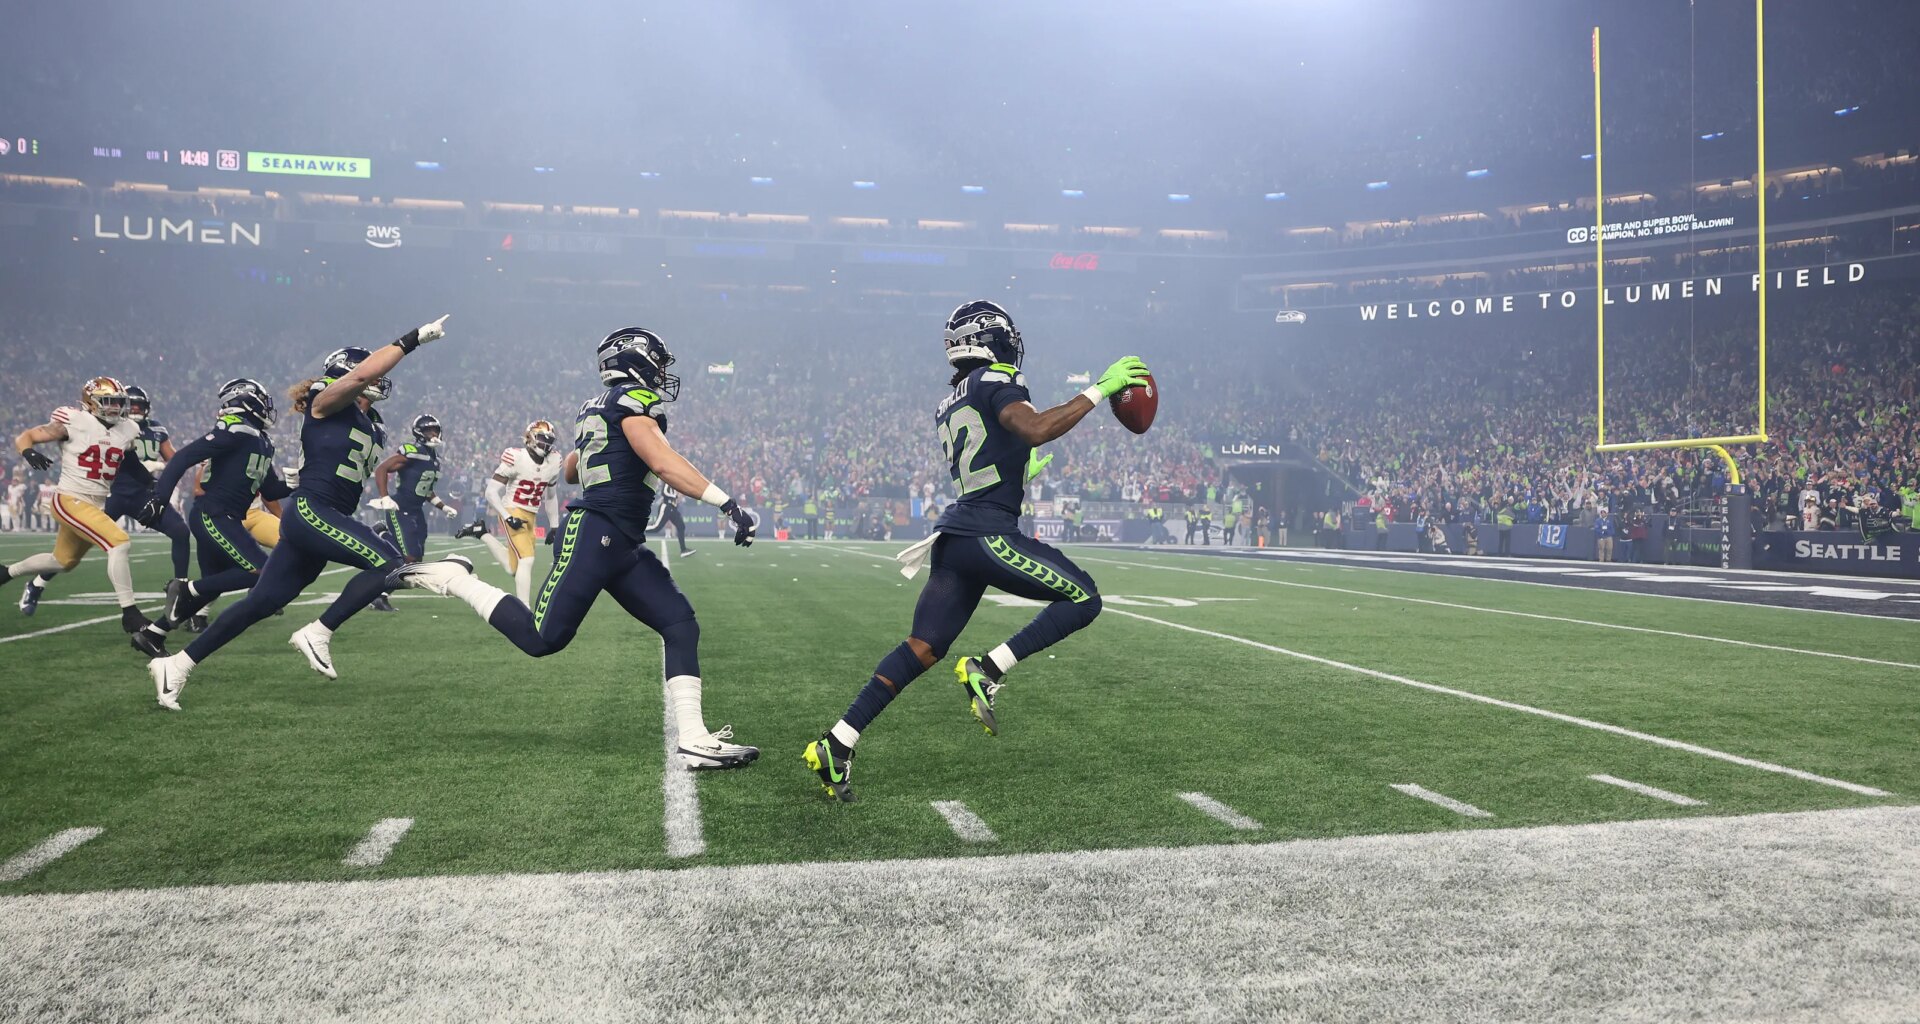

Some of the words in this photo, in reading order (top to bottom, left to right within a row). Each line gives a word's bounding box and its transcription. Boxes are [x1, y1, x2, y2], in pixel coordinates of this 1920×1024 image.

[180, 149, 209, 166] 14:49
[221, 153, 236, 168] 25
[262, 157, 358, 173] SEAHAWKS
[94, 213, 261, 246] LUMEN
[366, 225, 401, 240] aws
[1590, 223, 1622, 234] PAYER
[1623, 220, 1642, 230] AND
[1643, 217, 1670, 228] SUPER
[1672, 214, 1697, 225] BOWL
[1590, 230, 1637, 241] CAMPION,
[1665, 223, 1689, 233] DOUG
[1691, 217, 1734, 230] BALDWIN!
[1569, 229, 1586, 242] CC
[1360, 296, 1514, 320] WELCOME
[1538, 291, 1576, 309] TO
[1603, 277, 1722, 304] LUMEN
[1221, 444, 1281, 456] LUMEN
[77, 444, 123, 480] 49
[245, 452, 272, 495] 4
[1545, 525, 1561, 545] 12
[1720, 497, 1731, 569] SEAHAWKS
